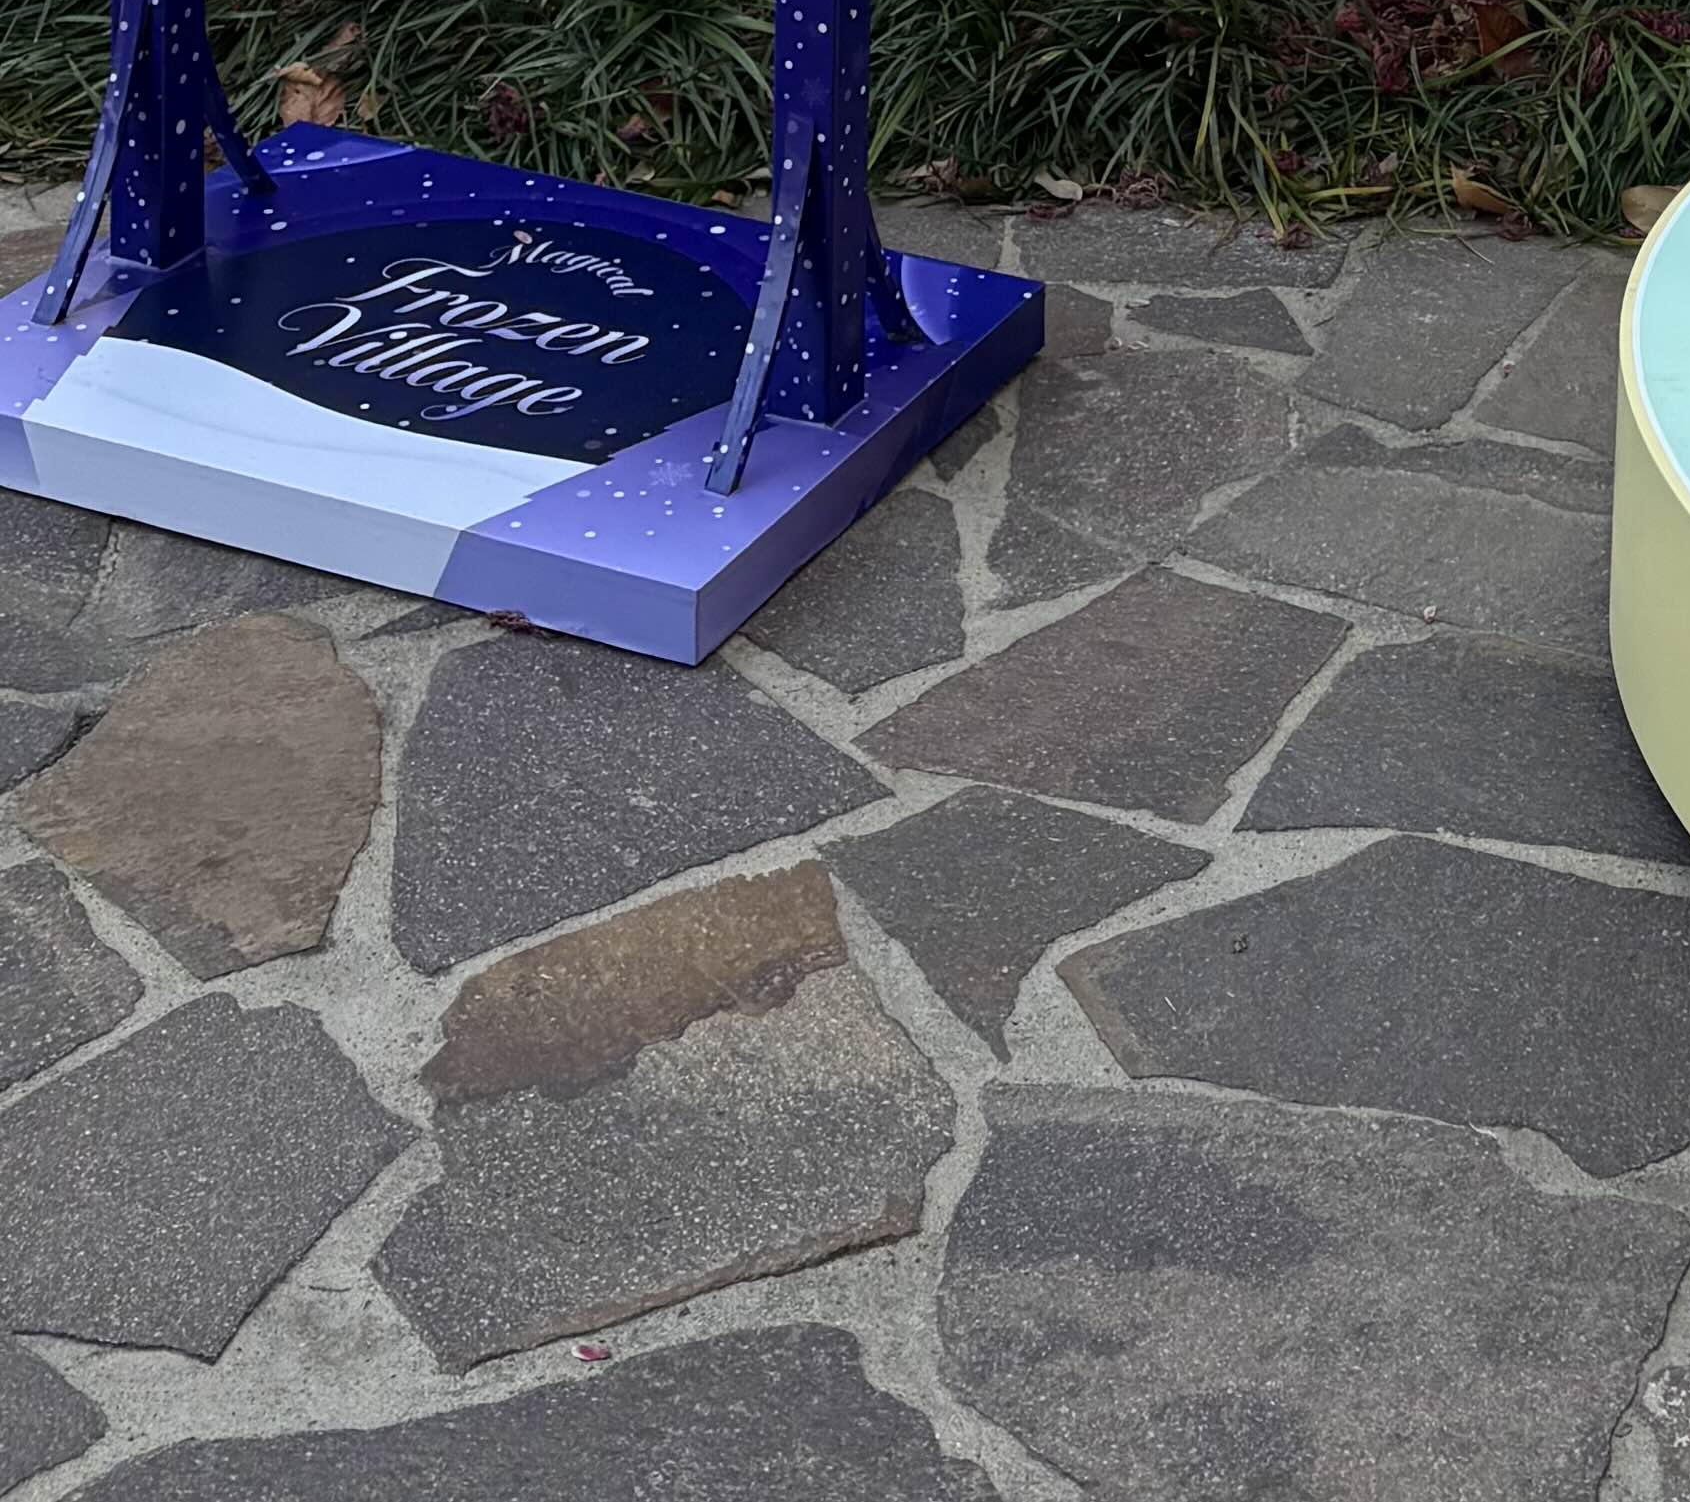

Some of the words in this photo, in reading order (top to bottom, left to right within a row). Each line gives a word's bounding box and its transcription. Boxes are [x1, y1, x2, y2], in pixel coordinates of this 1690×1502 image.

[334, 257, 651, 365] Frozen
[478, 240, 655, 297] Magical
[277, 302, 584, 422] Village
